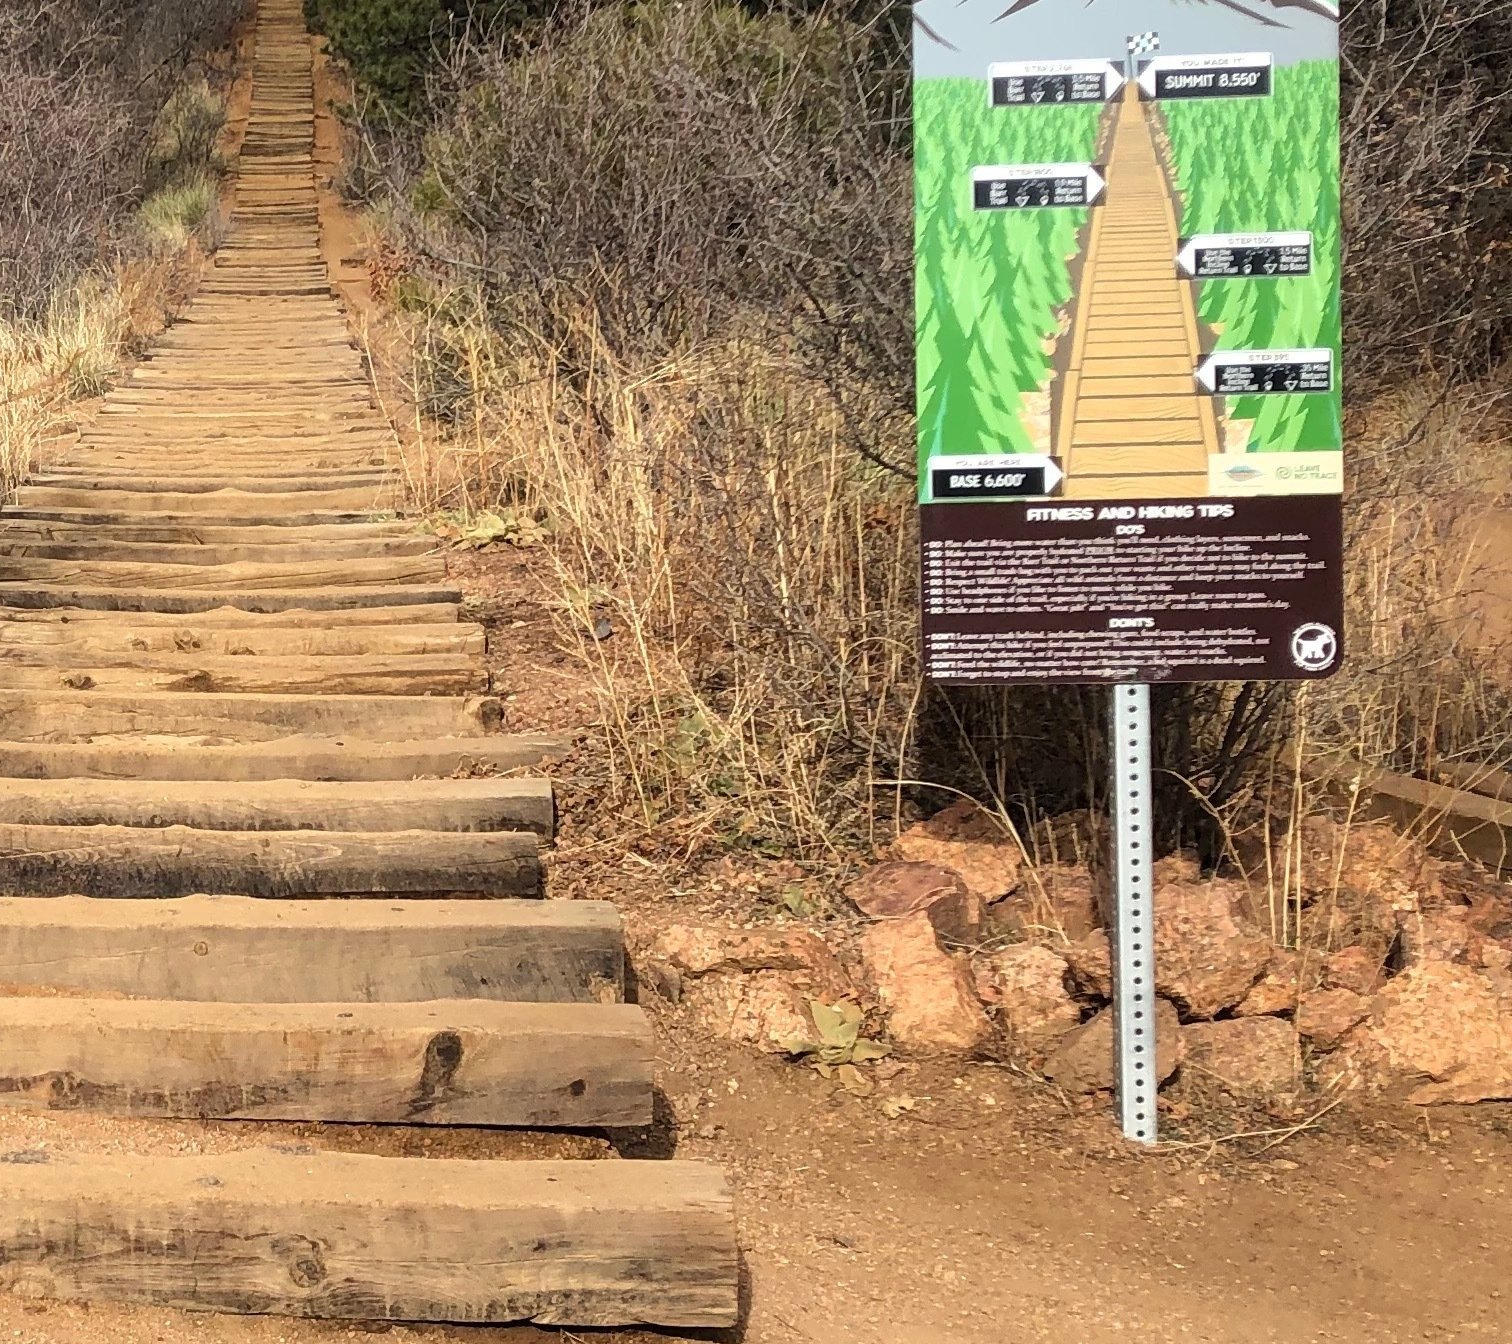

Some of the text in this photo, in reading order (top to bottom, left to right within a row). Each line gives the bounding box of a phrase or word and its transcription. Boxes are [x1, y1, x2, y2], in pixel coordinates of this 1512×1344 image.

[1164, 73, 1216, 90] SUMMIT
[949, 474, 982, 489] BASE
[1026, 504, 1235, 522] FITNESS AND HIKING TIPS
